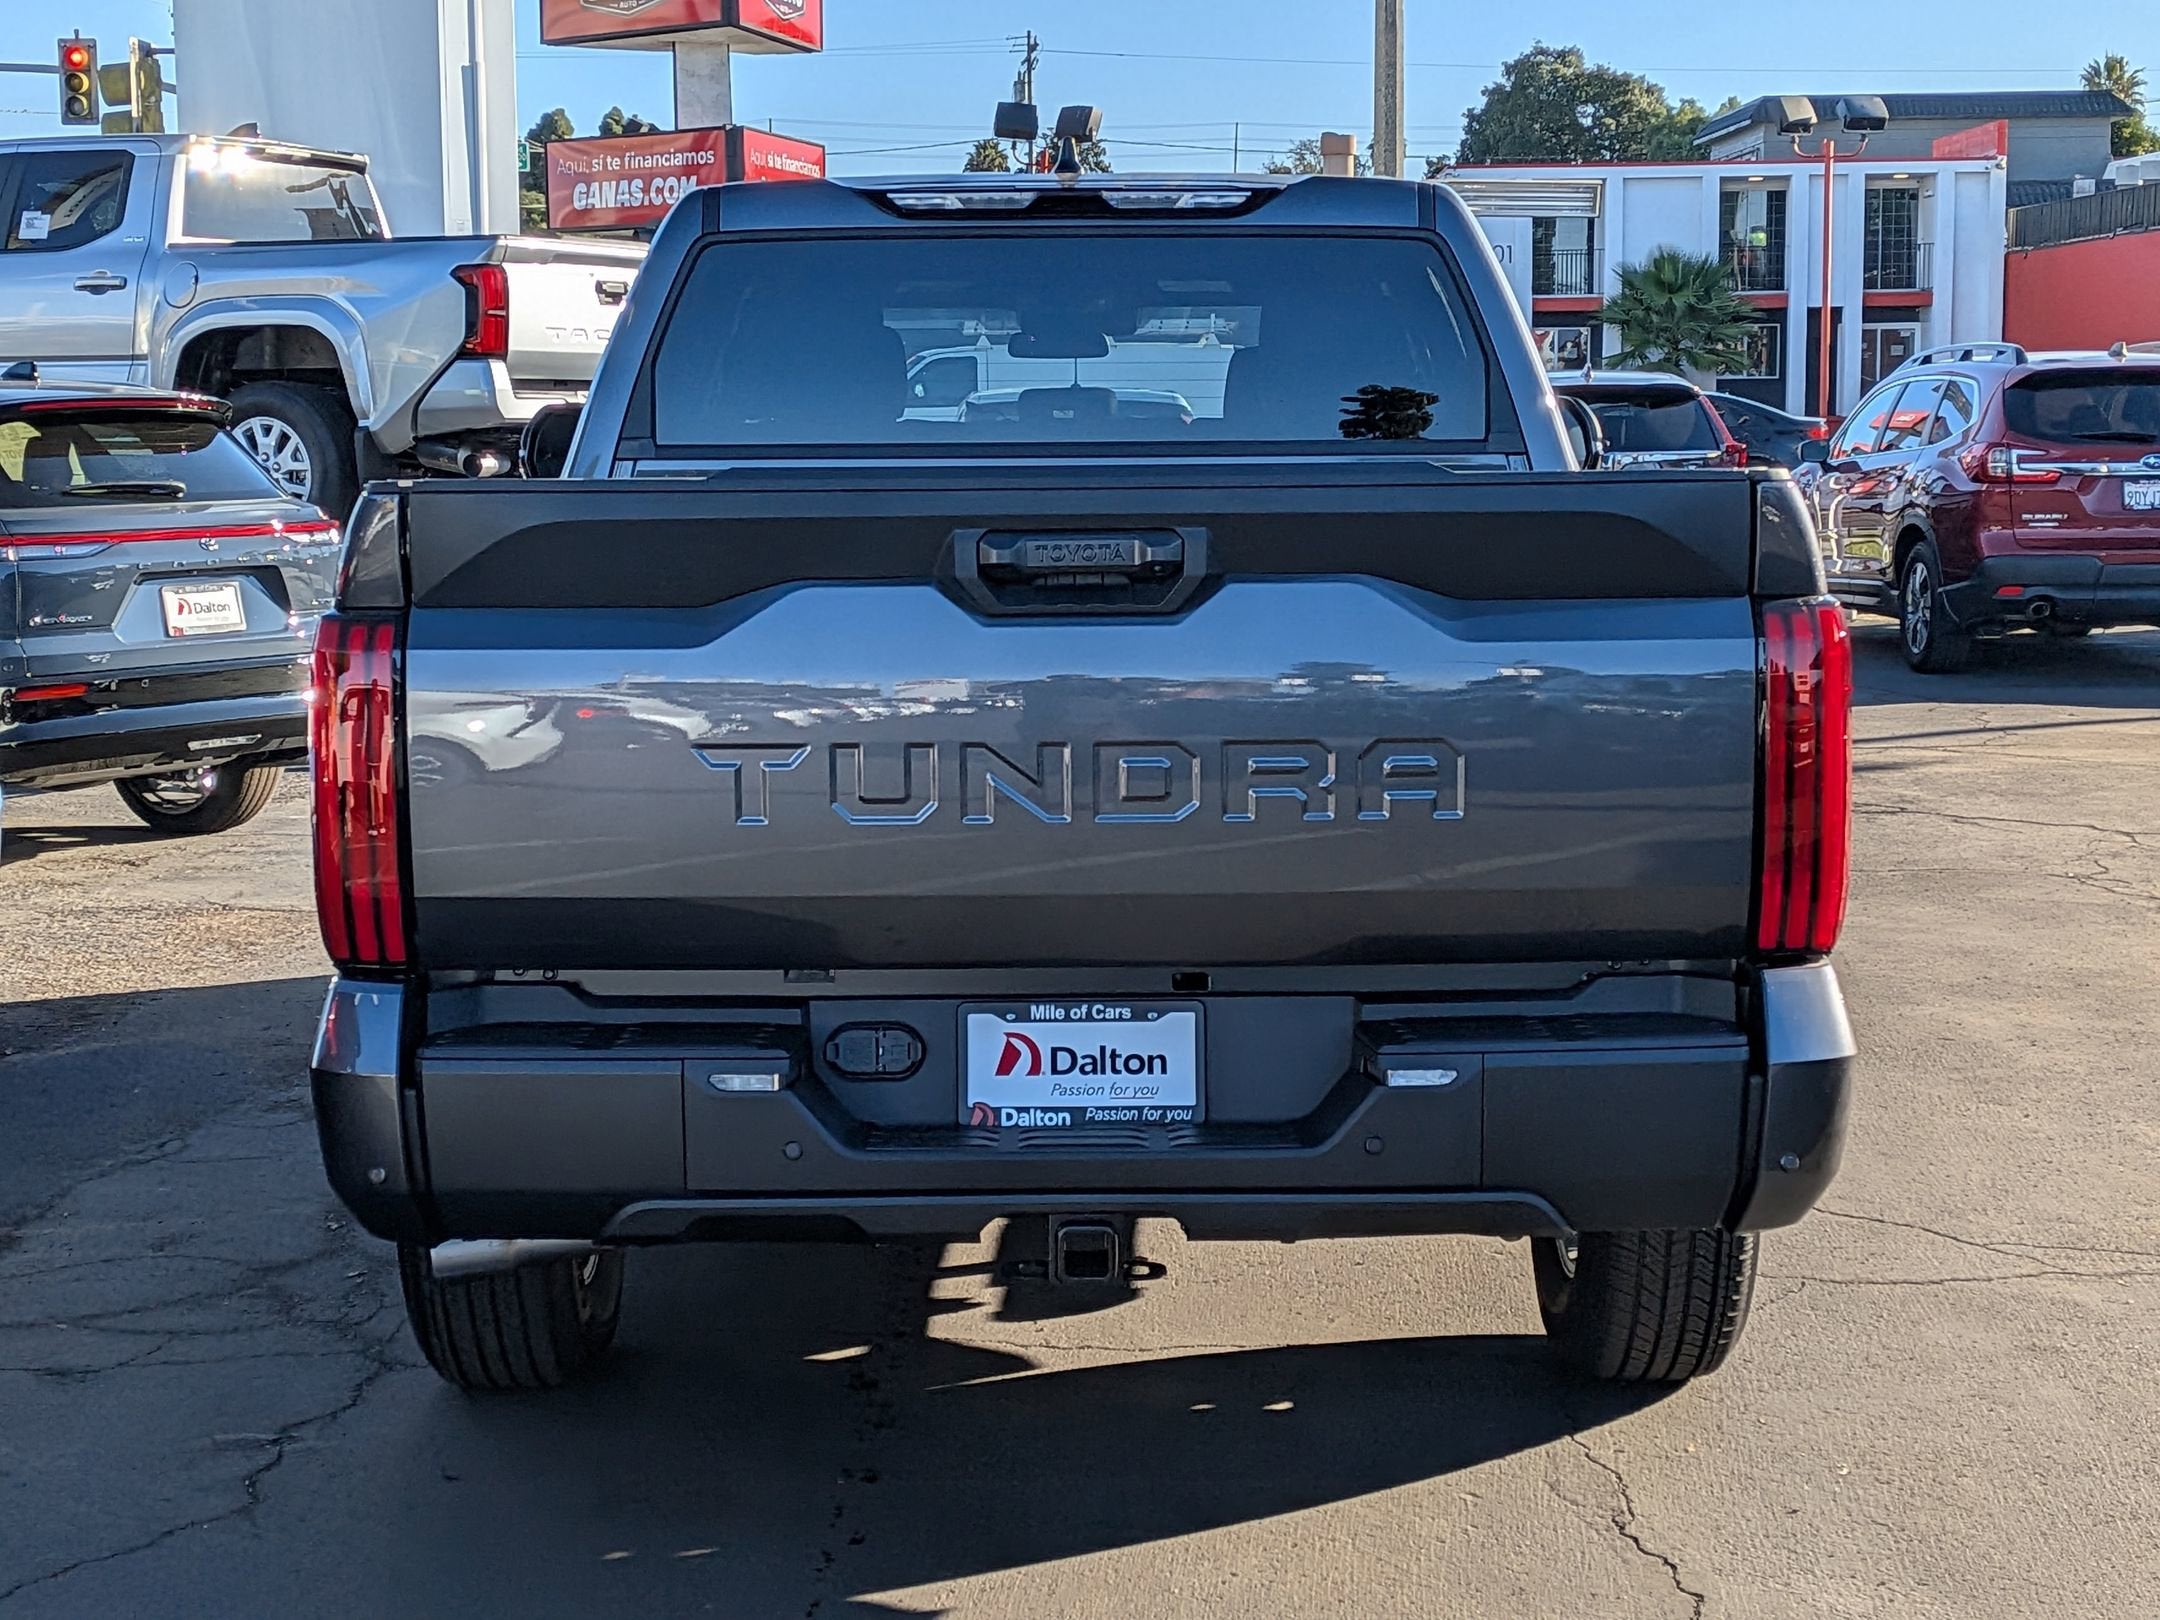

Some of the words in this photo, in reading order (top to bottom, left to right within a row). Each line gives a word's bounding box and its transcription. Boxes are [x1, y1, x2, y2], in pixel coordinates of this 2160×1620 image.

[606, 155, 621, 171] te
[624, 148, 715, 170] financiamos
[1034, 543, 1126, 562] TOYOTA
[193, 601, 231, 614] Dalton
[691, 738, 1466, 826] TUNDRA
[1030, 1004, 1067, 1020] Mile
[1071, 1004, 1088, 1020] of
[1091, 1004, 1132, 1020] Cars
[1050, 1045, 1168, 1076] Dalton
[1050, 1083, 1105, 1097] Passion
[1109, 1082, 1131, 1097] for
[1131, 1085, 1160, 1099] you
[1000, 1107, 1071, 1127] Dalton
[1085, 1107, 1138, 1122] Passion
[1141, 1106, 1162, 1122] for
[1165, 1109, 1193, 1124] you
